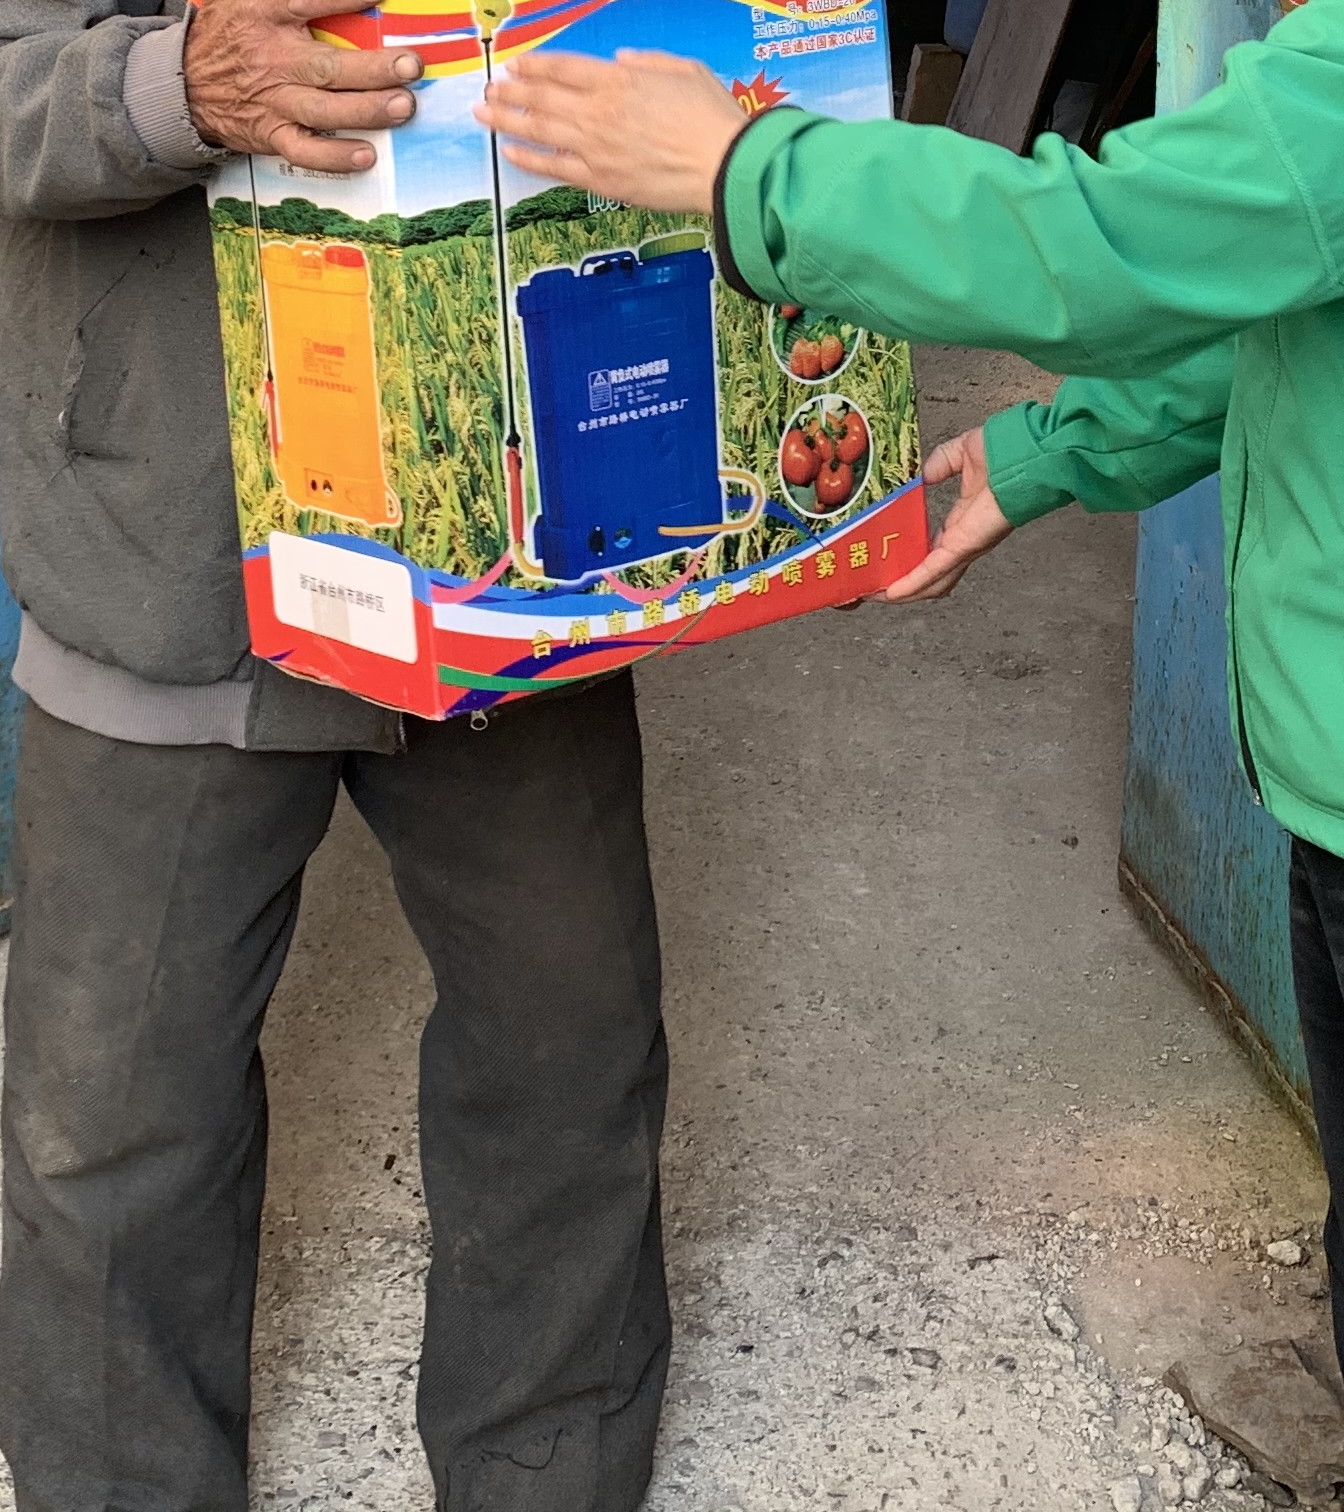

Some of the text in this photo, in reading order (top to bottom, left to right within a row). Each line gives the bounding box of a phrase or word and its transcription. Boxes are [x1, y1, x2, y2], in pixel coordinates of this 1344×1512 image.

[755, 28, 875, 59] 本产品通过国家3C认证
[530, 532, 900, 659] 台州市路桥电动喷雾器厂
